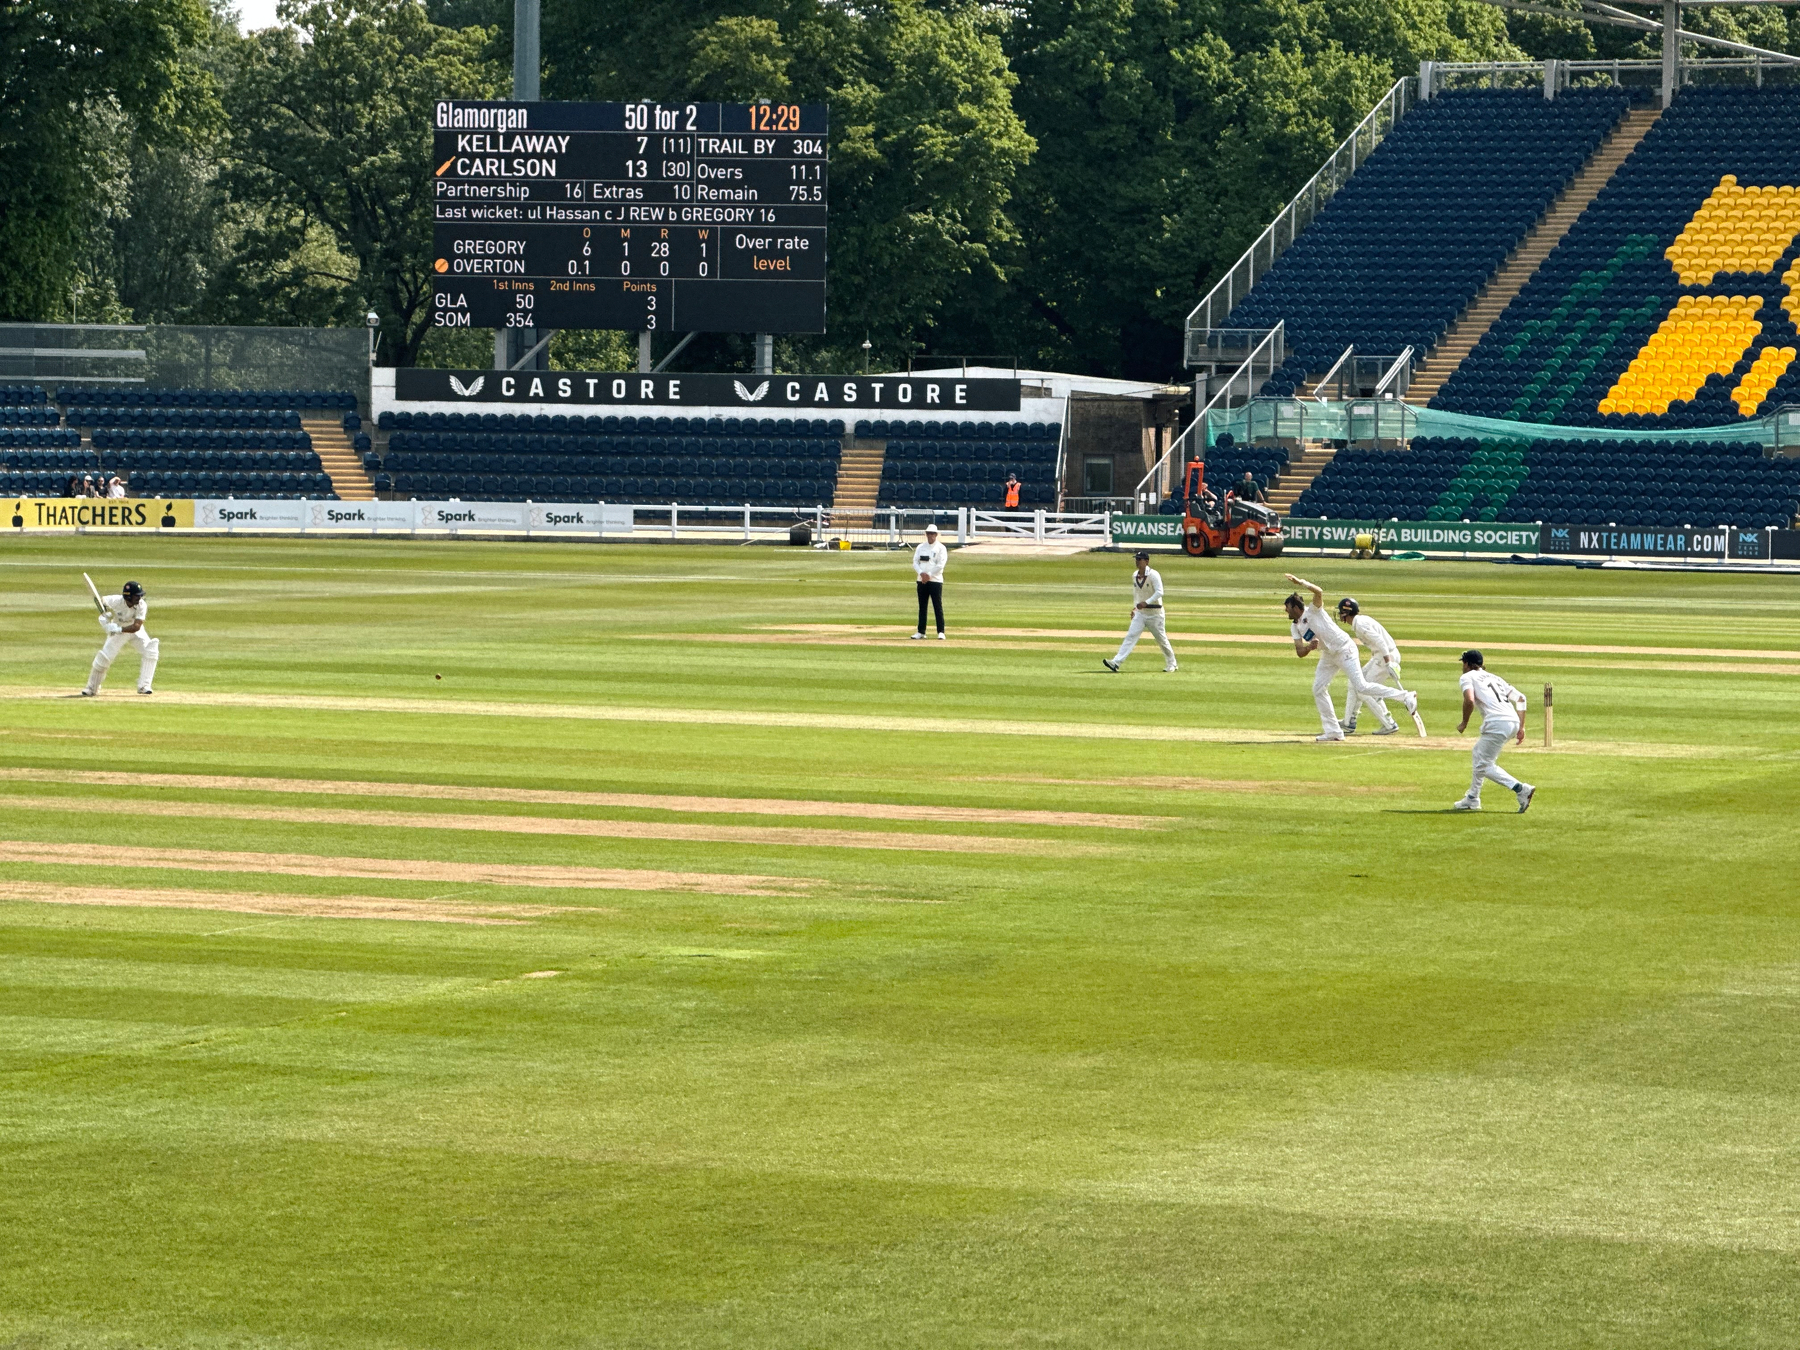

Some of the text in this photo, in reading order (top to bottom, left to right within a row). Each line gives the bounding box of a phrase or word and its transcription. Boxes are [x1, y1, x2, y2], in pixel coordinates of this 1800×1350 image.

[437, 102, 527, 131] Glamorgan
[625, 105, 697, 130] 50 for 2
[749, 106, 799, 130] 12:29
[458, 135, 570, 153] KELLAWAY
[637, 137, 648, 154] 7
[663, 137, 690, 155] (11)
[698, 139, 775, 154] TRAIL BY
[793, 140, 822, 155] 304
[457, 158, 556, 176] CARLSON
[626, 160, 647, 177] 13
[663, 161, 690, 178] (30)
[698, 164, 742, 179] Overs
[791, 165, 821, 179] 11.1
[437, 182, 529, 202] Partnership
[566, 183, 581, 198] 16
[594, 184, 643, 199] Extras
[674, 185, 690, 199] 10
[698, 185, 757, 200] Remain
[790, 186, 822, 201] 75.5
[437, 205, 775, 222] Last wicket: ul Hassan c J REW b GREGORY 16
[621, 228, 630, 238] M
[661, 229, 668, 239] R
[698, 229, 709, 239] W
[454, 240, 526, 254] GREGORY
[583, 242, 591, 255] 6
[736, 234, 809, 249] Over rate
[623, 242, 628, 256] 1
[651, 242, 669, 257] 28
[700, 243, 706, 257] 1
[454, 259, 525, 273] OVERTON
[568, 260, 590, 275] 0.1
[622, 261, 630, 275] 0
[660, 262, 668, 276] 0
[700, 262, 707, 276] 0
[754, 256, 790, 270] level
[493, 280, 534, 291] 1st Inns
[550, 281, 595, 291] 2nd Inns
[624, 281, 656, 292] Points
[436, 293, 467, 307] GLA
[516, 294, 534, 309] 50
[647, 296, 656, 310] 3
[435, 312, 470, 326] SOM
[506, 313, 534, 327] 354
[647, 315, 656, 329] 3
[502, 377, 681, 400] CASTORE
[787, 382, 968, 404] CASTORE
[35, 503, 146, 526] THATCHERS
[219, 508, 257, 522] Spark
[328, 509, 365, 523] Spark
[438, 510, 475, 523] Spark
[546, 512, 583, 526] Spark
[1113, 522, 1185, 536] SWANSEA
[1281, 526, 1322, 540] CIETY
[1401, 529, 1471, 543] BUILDING
[1474, 531, 1539, 545] SOCIETY
[1579, 531, 1725, 552] NXTEAMWEAR.COM
